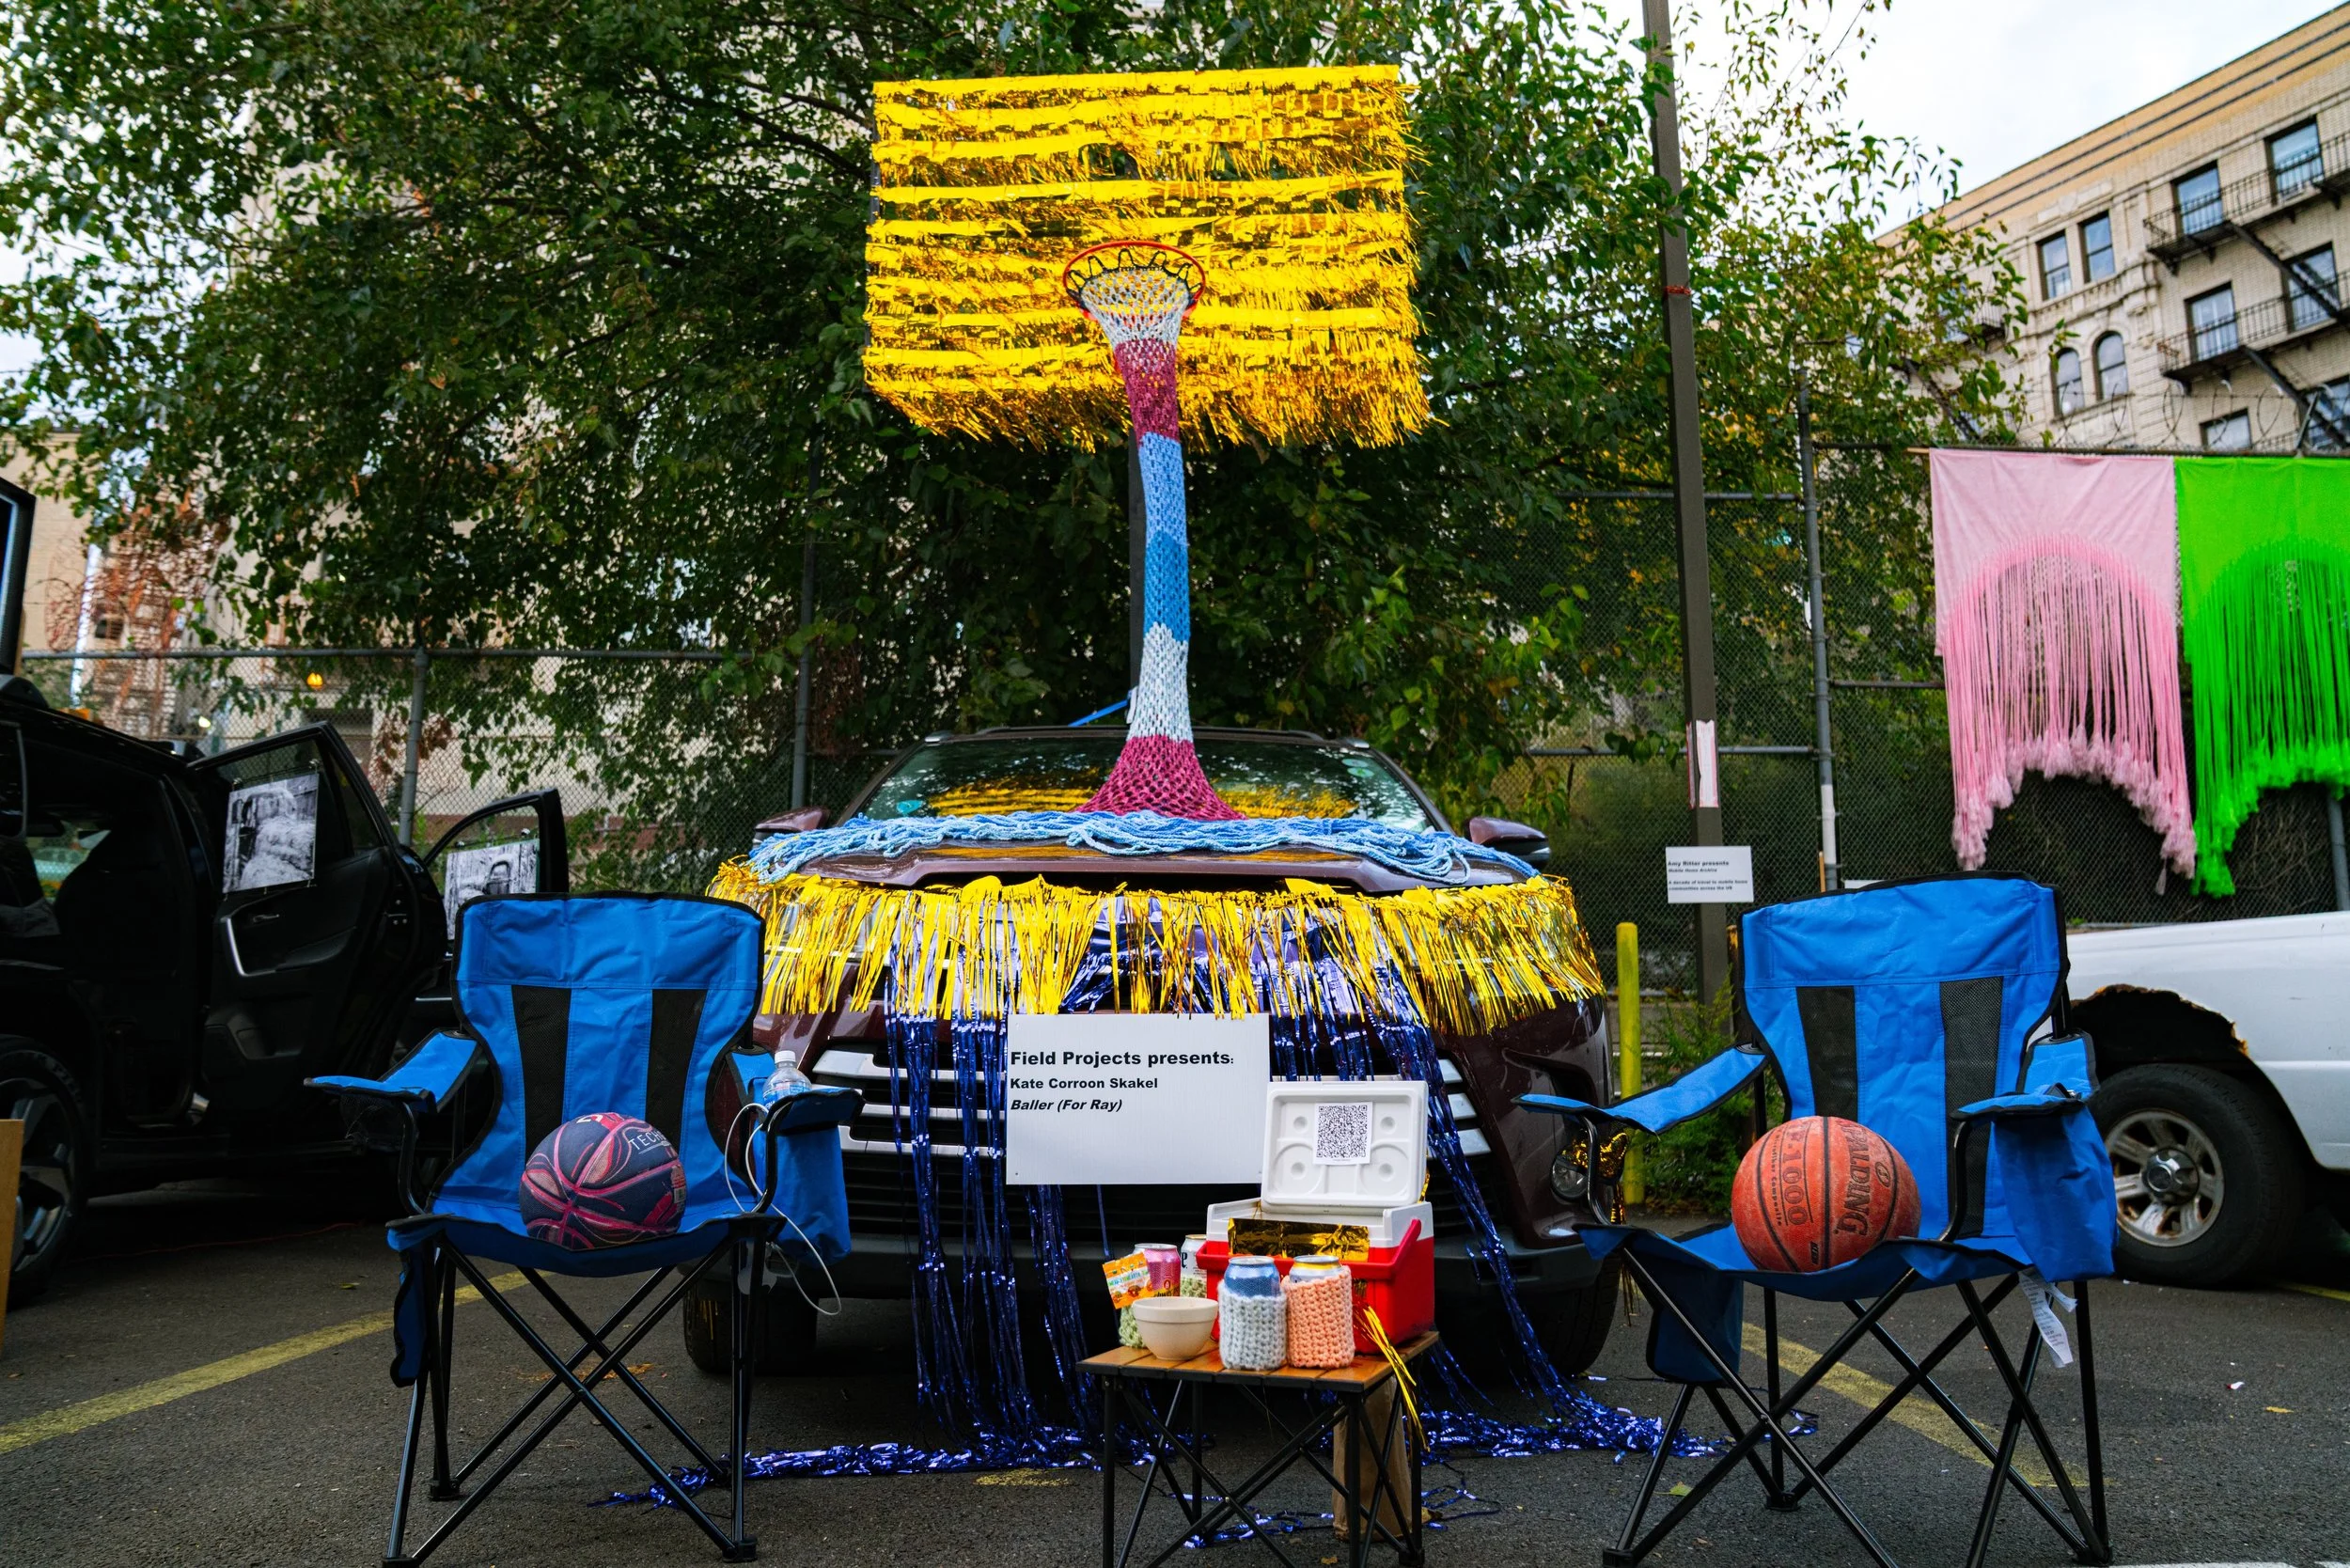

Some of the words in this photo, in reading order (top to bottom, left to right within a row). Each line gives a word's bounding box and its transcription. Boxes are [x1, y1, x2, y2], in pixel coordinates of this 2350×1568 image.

[1010, 1051, 1056, 1065] Field
[1062, 1051, 1141, 1068] Projects
[1148, 1051, 1234, 1068] presents:
[1010, 1077, 1043, 1089] Kate
[1048, 1077, 1104, 1089] Corroon
[1109, 1077, 1158, 1089] Skakel
[1010, 1099, 1054, 1110] Baller
[1057, 1099, 1087, 1113] (For
[1089, 1099, 1122, 1113] Ray)
